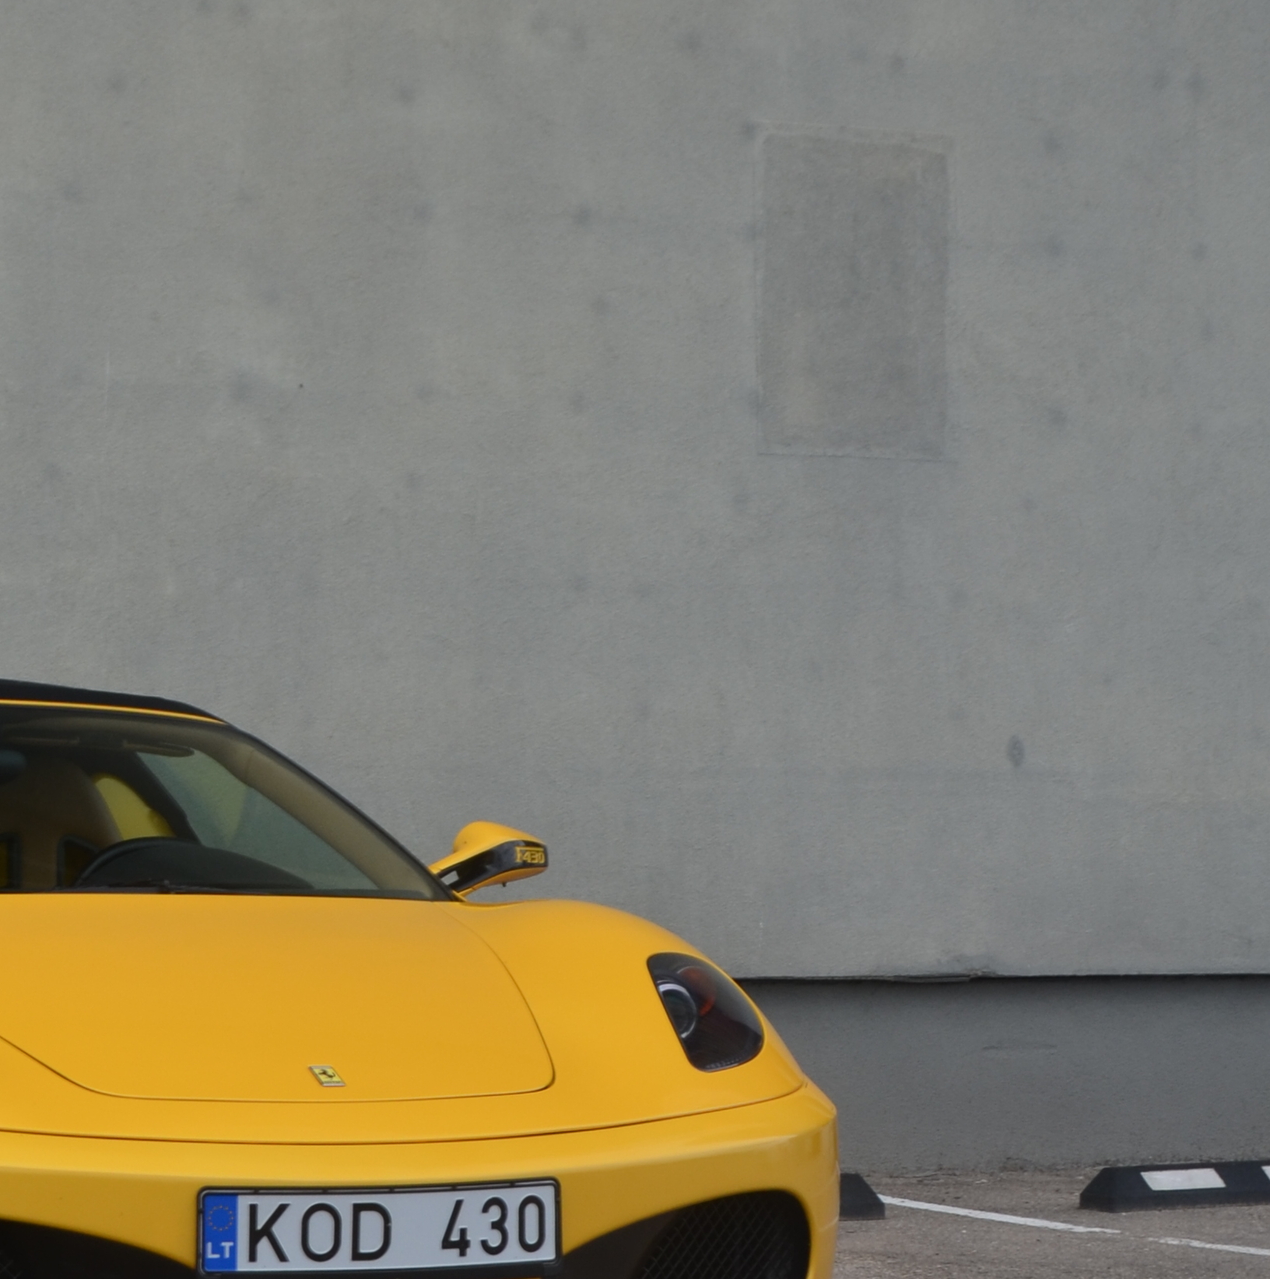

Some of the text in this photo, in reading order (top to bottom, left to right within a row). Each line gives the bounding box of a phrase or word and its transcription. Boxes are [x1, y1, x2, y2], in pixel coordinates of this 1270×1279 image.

[248, 1194, 546, 1263] KOD 430
[206, 1242, 234, 1259] LT
